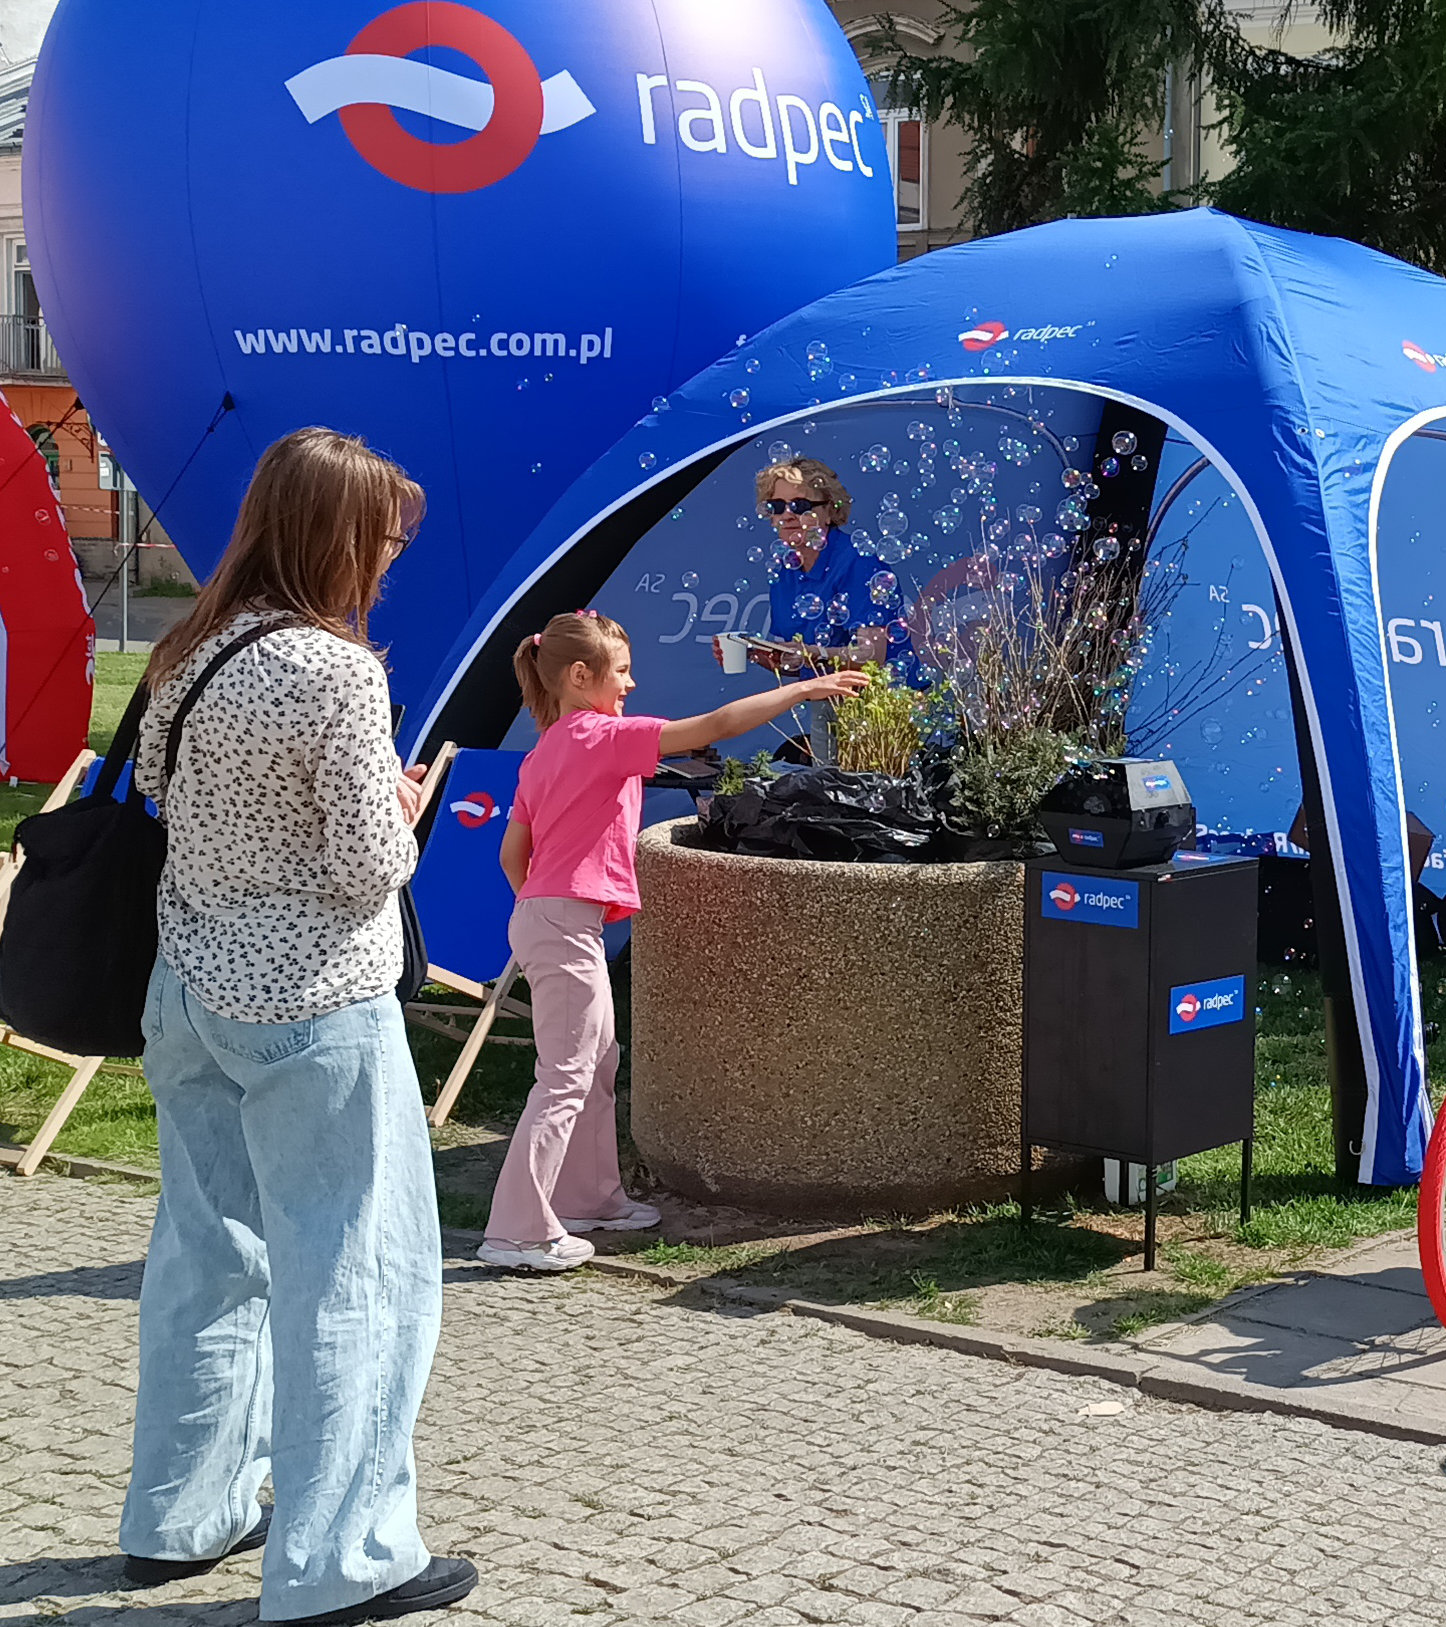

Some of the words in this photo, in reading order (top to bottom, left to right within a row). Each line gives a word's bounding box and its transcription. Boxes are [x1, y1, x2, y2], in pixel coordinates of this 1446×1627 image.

[636, 66, 873, 186] radpec
[234, 322, 613, 364] www.radpec.com.pl
[1013, 324, 1083, 343] radpec
[1084, 892, 1125, 910] radpec
[1203, 993, 1234, 1011] radpec
